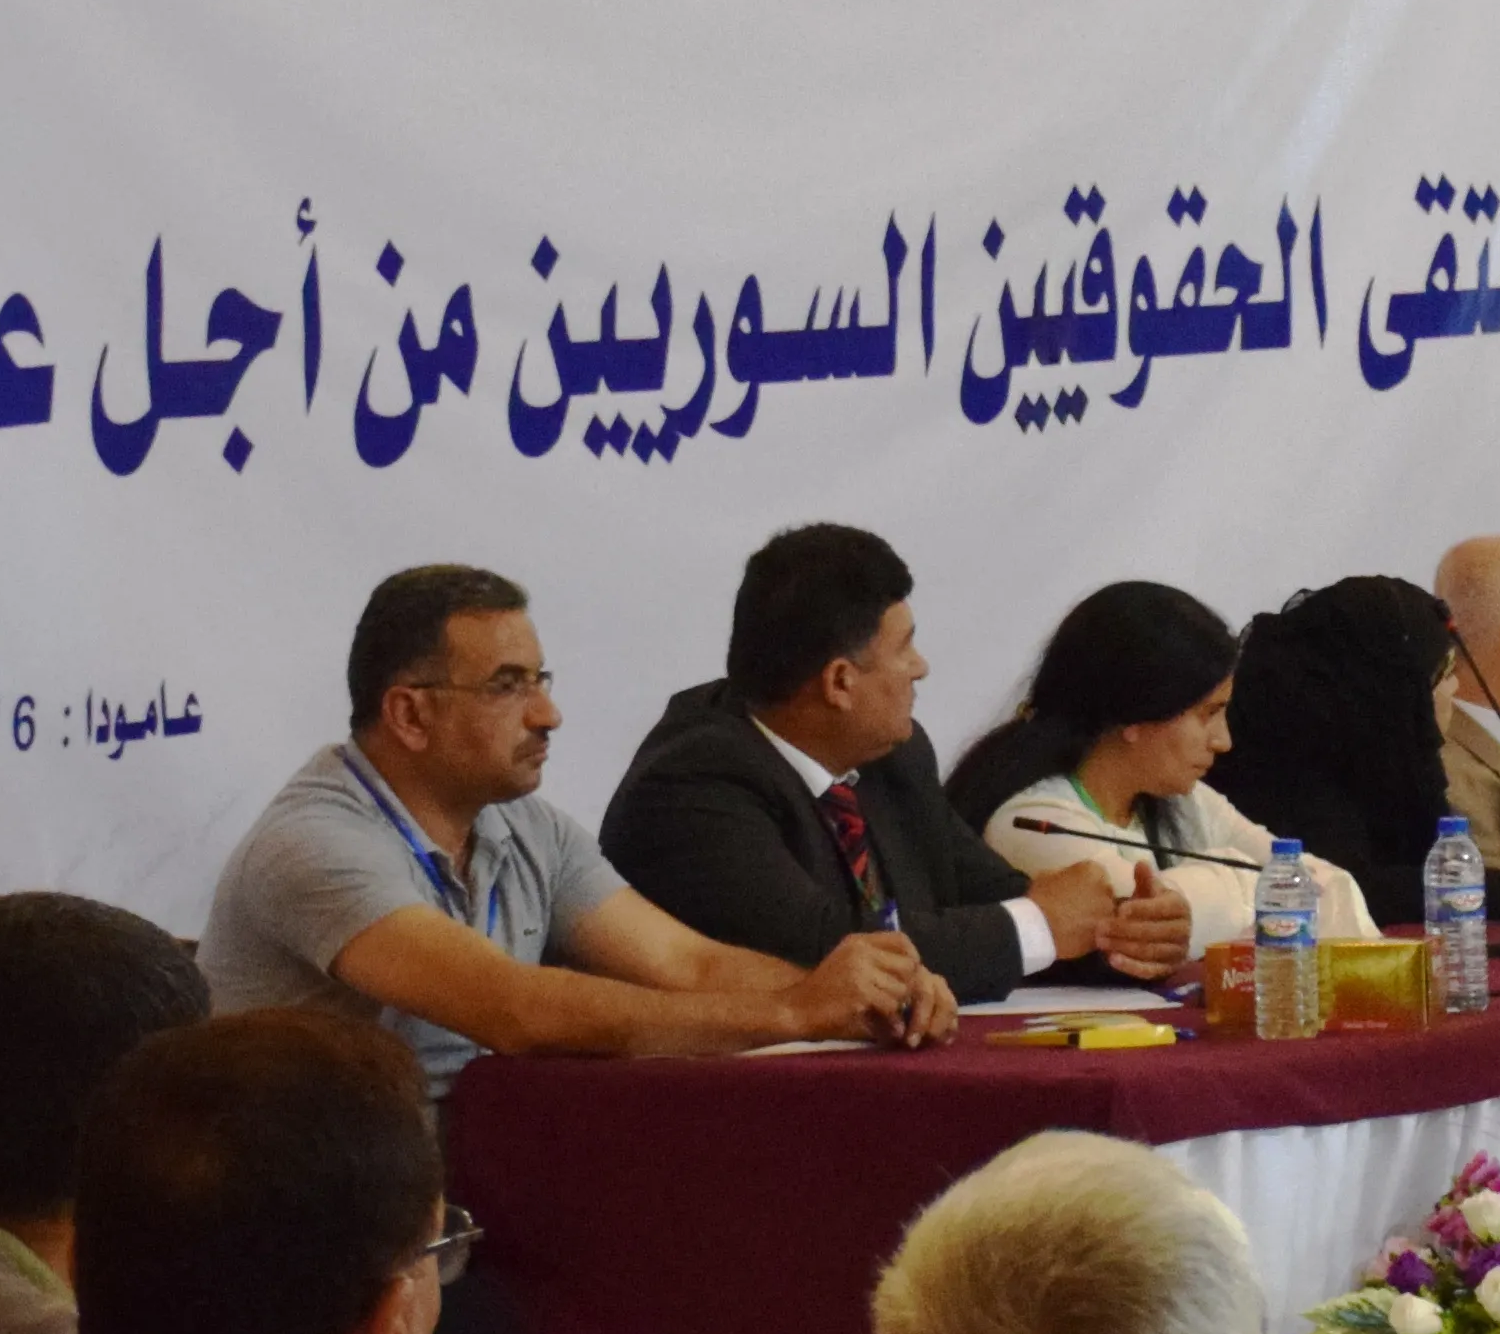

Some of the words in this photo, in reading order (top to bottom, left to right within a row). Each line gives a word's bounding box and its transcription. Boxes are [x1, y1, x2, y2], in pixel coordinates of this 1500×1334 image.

[90, 195, 323, 476] أجل
[353, 239, 478, 468] من
[507, 207, 937, 465] السوريين
[959, 181, 1328, 434] الحقوقيين
[87, 677, 202, 760] عامودا
